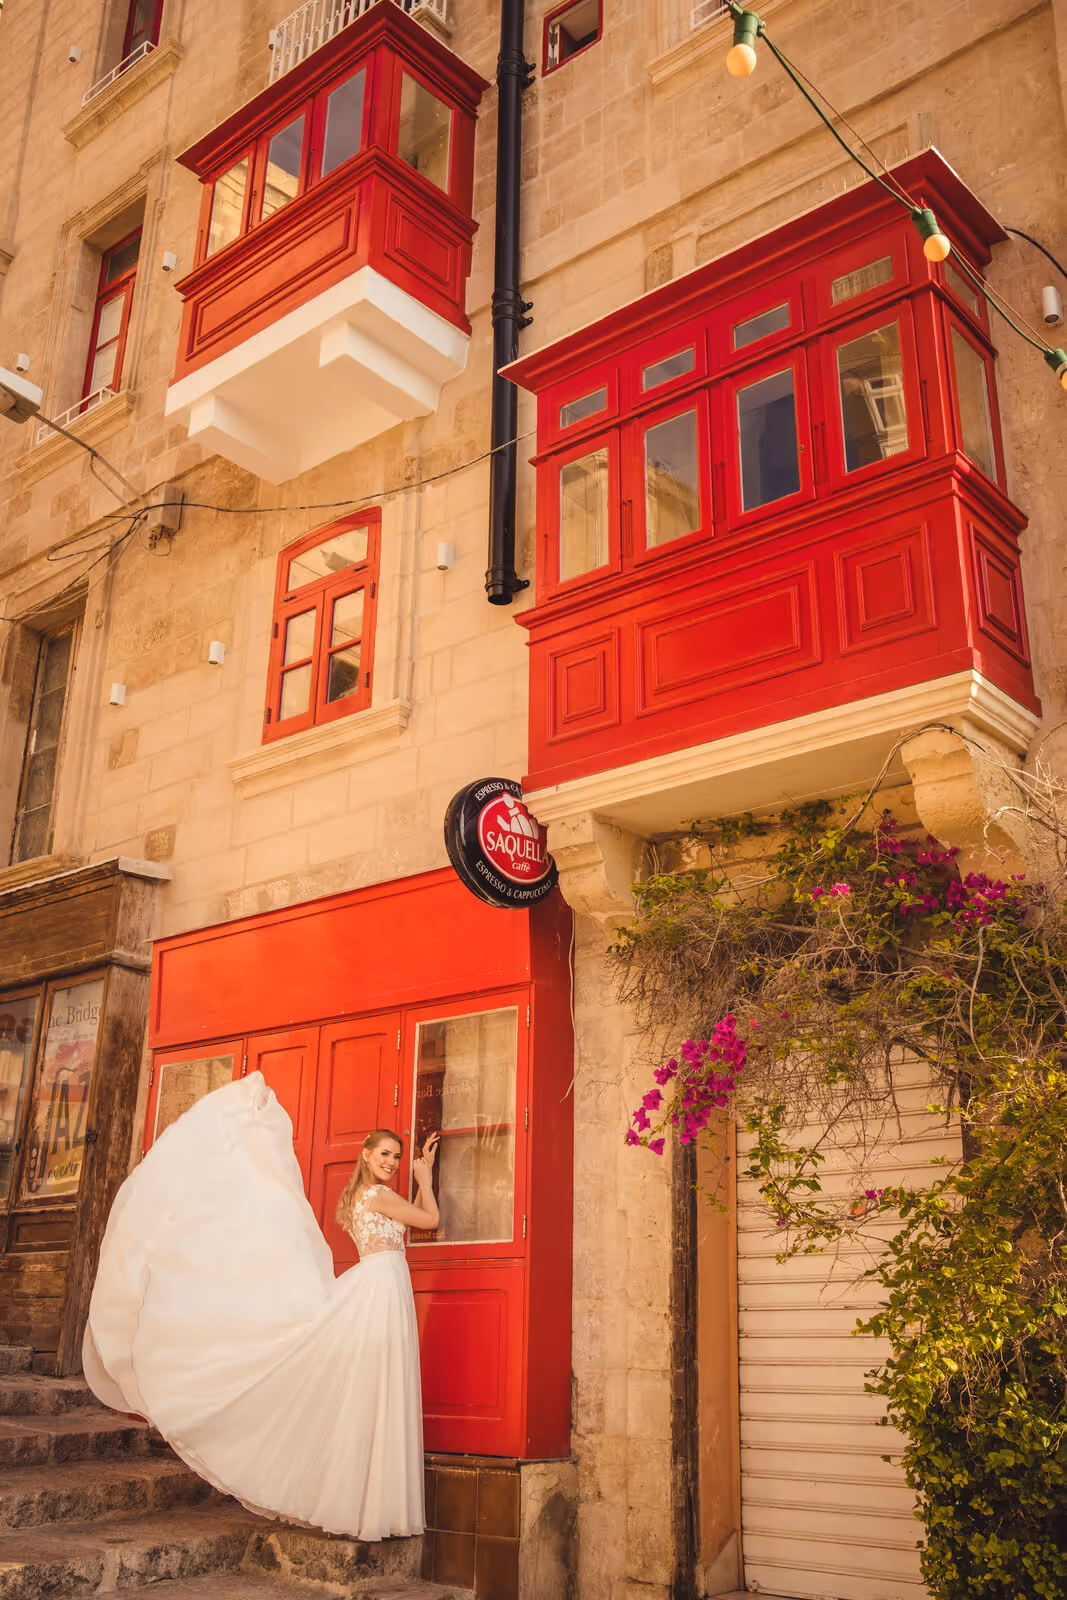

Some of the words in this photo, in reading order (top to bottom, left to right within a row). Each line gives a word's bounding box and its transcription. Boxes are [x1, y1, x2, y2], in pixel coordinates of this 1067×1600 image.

[474, 782, 503, 801] ESPRESSO
[503, 782, 510, 790] &
[475, 860, 506, 893] ESPRESSO
[506, 888, 513, 897] &
[513, 879, 552, 899] CAPPUCCINO
[66, 1001, 99, 1025] Bridg
